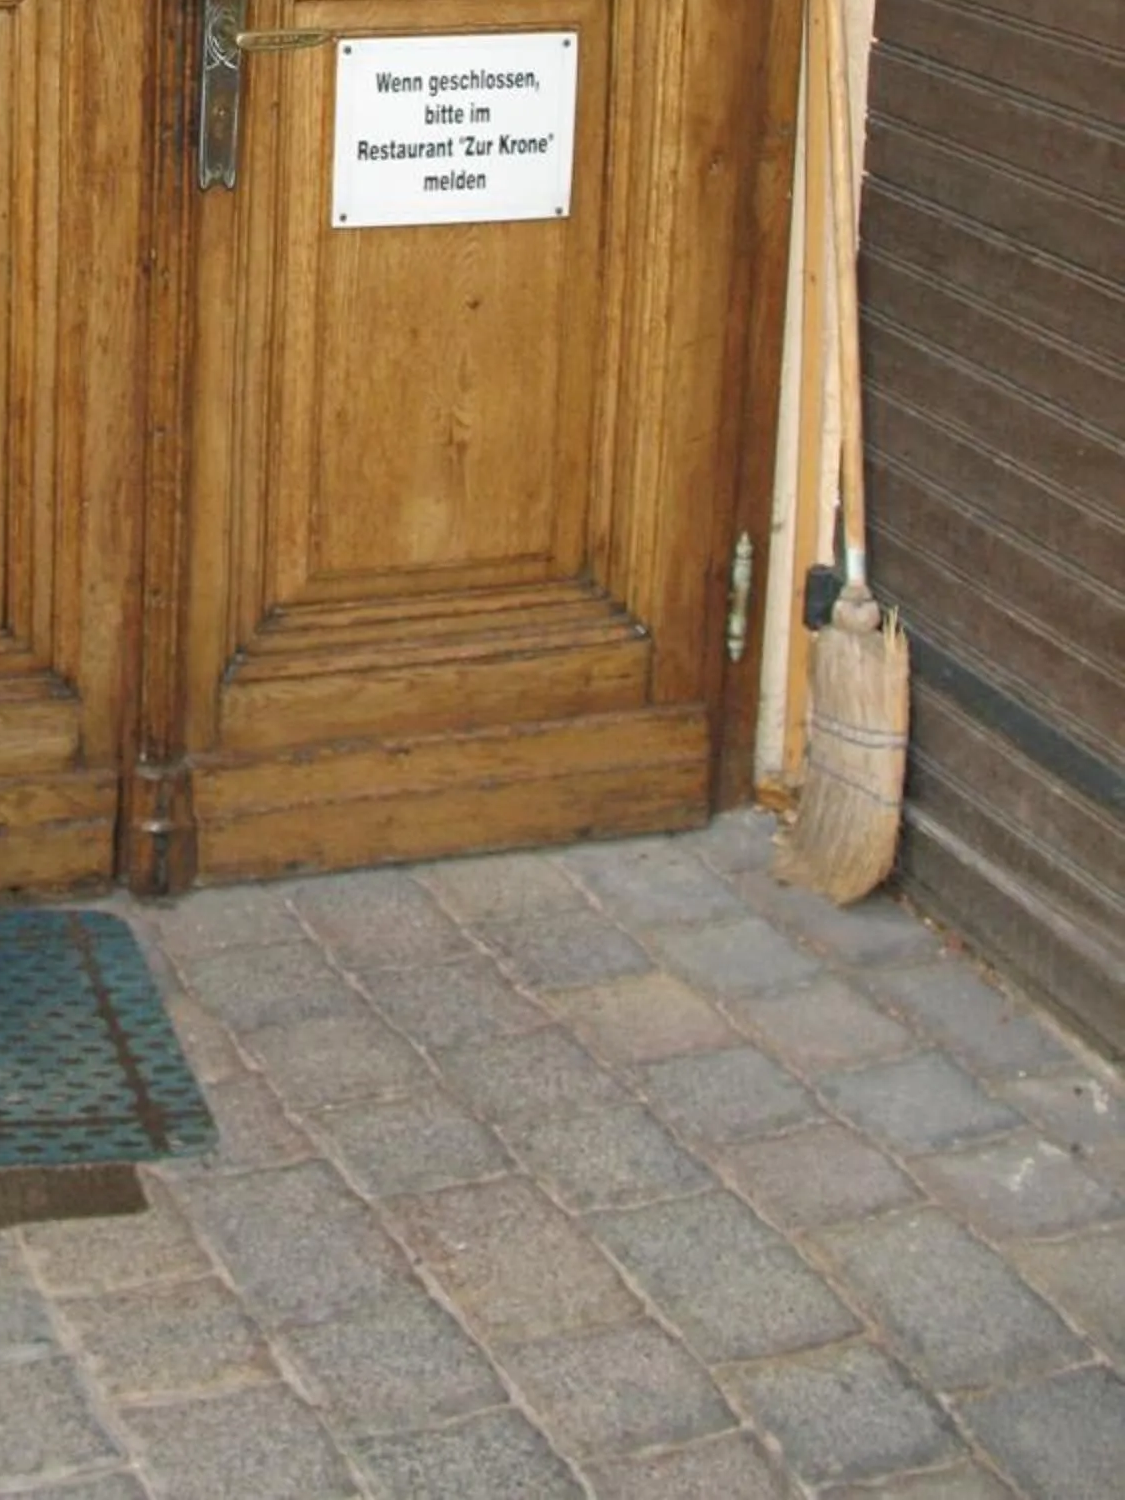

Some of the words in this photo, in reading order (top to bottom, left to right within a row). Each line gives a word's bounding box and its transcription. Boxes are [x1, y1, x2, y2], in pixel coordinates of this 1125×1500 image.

[376, 72, 423, 93] Wenn
[428, 69, 540, 97] geschlossen,
[425, 104, 464, 124] bitte
[469, 102, 491, 123] im
[357, 137, 454, 161] Restaurant
[423, 170, 487, 192] melden
